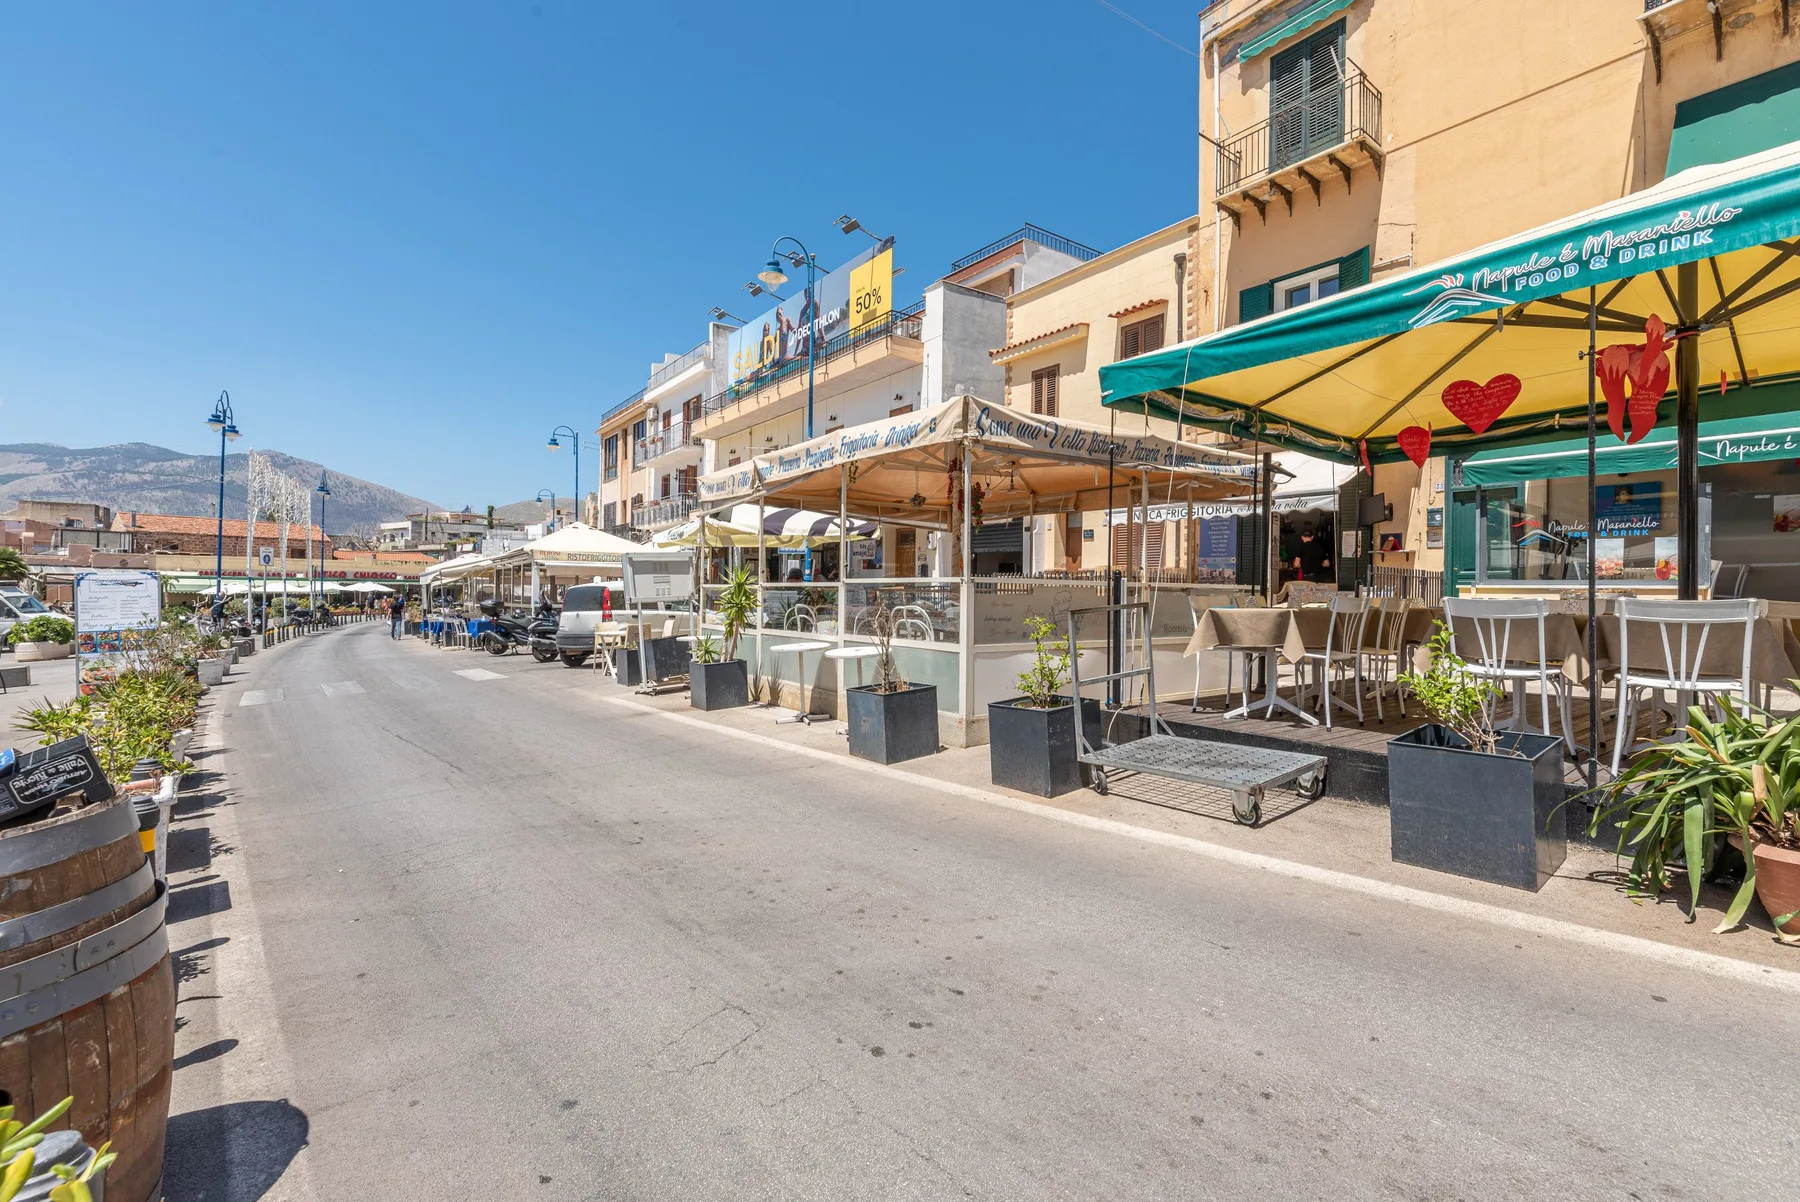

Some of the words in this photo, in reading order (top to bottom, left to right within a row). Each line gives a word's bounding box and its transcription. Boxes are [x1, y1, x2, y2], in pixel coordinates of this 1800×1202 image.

[1472, 252, 1556, 292] Napule
[1558, 243, 1578, 263] é
[1583, 202, 1742, 260] Masaniello
[1515, 263, 1579, 291] FOOD
[1589, 255, 1608, 270] &
[1619, 229, 1714, 264] DRINK
[856, 286, 881, 314] 50%
[733, 329, 780, 380] SALDI
[840, 430, 879, 459] Friggitoria
[976, 407, 1013, 437] Come
[1017, 422, 1040, 440] una
[1044, 420, 1087, 450] Volta
[1131, 439, 1160, 462] Pizzeria
[1716, 437, 1780, 461] Napule
[1784, 435, 1797, 450] é
[1284, 498, 1308, 509] volta
[1548, 520, 1586, 537] Napule
[1597, 517, 1659, 532] Masaniello
[1612, 529, 1649, 537] DRINK
[568, 553, 622, 562] RISTOFRIGGITOR
[353, 571, 397, 579] CHIOSCO
[58, 758, 86, 773] Valle
[13, 771, 47, 789] Ricote
